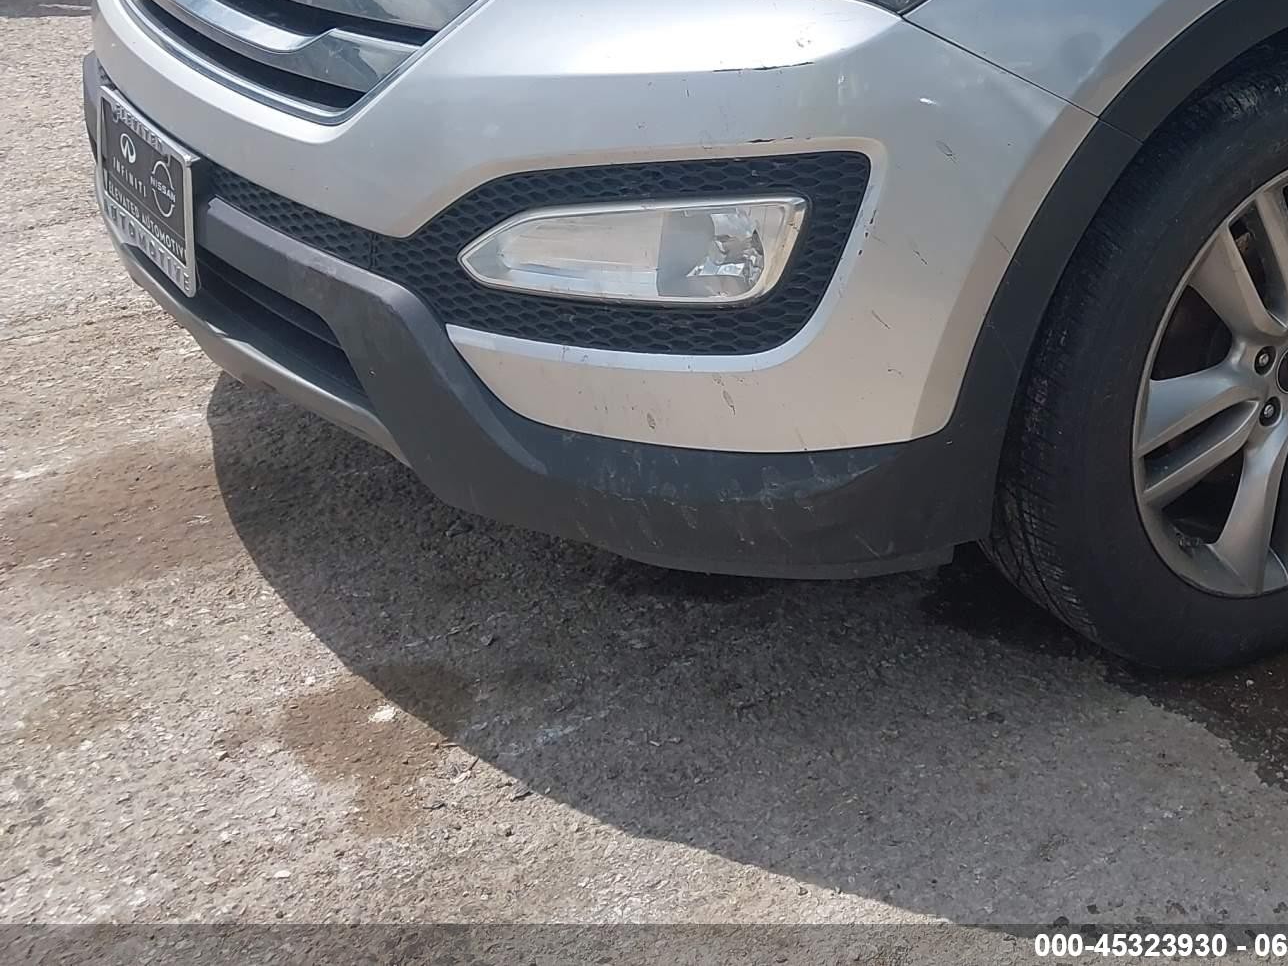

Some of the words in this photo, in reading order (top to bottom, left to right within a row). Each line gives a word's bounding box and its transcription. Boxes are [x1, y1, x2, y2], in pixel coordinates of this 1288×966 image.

[112, 156, 147, 198] INFINITI
[150, 175, 176, 203] NISSAN
[108, 180, 140, 219] ELEVATED
